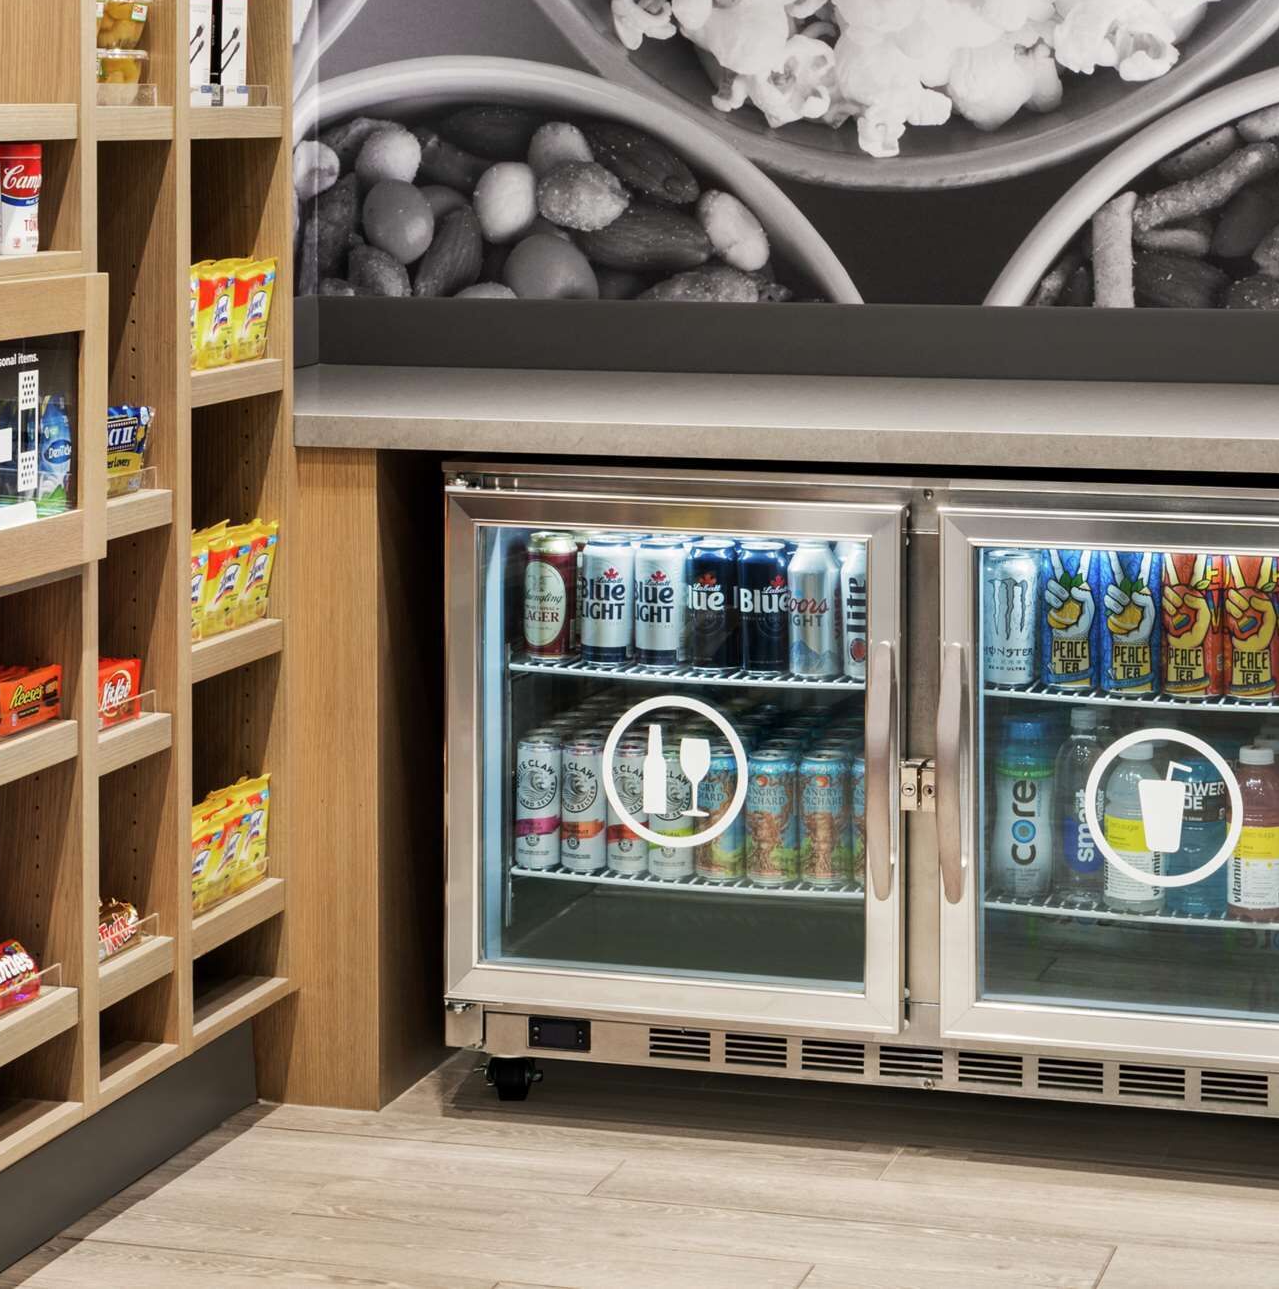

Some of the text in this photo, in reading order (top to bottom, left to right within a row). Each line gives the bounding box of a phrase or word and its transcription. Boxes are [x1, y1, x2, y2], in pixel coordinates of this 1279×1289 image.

[18, 352, 39, 365] items.
[688, 585, 725, 611] lue
[635, 605, 673, 623] IGHT
[1053, 640, 1088, 659] PEACE
[1114, 645, 1149, 664] PEACE
[1169, 648, 1202, 668] PEACE
[1234, 650, 1269, 670] PEACE
[528, 759, 555, 775] CLAW
[568, 762, 595, 780] CLAW
